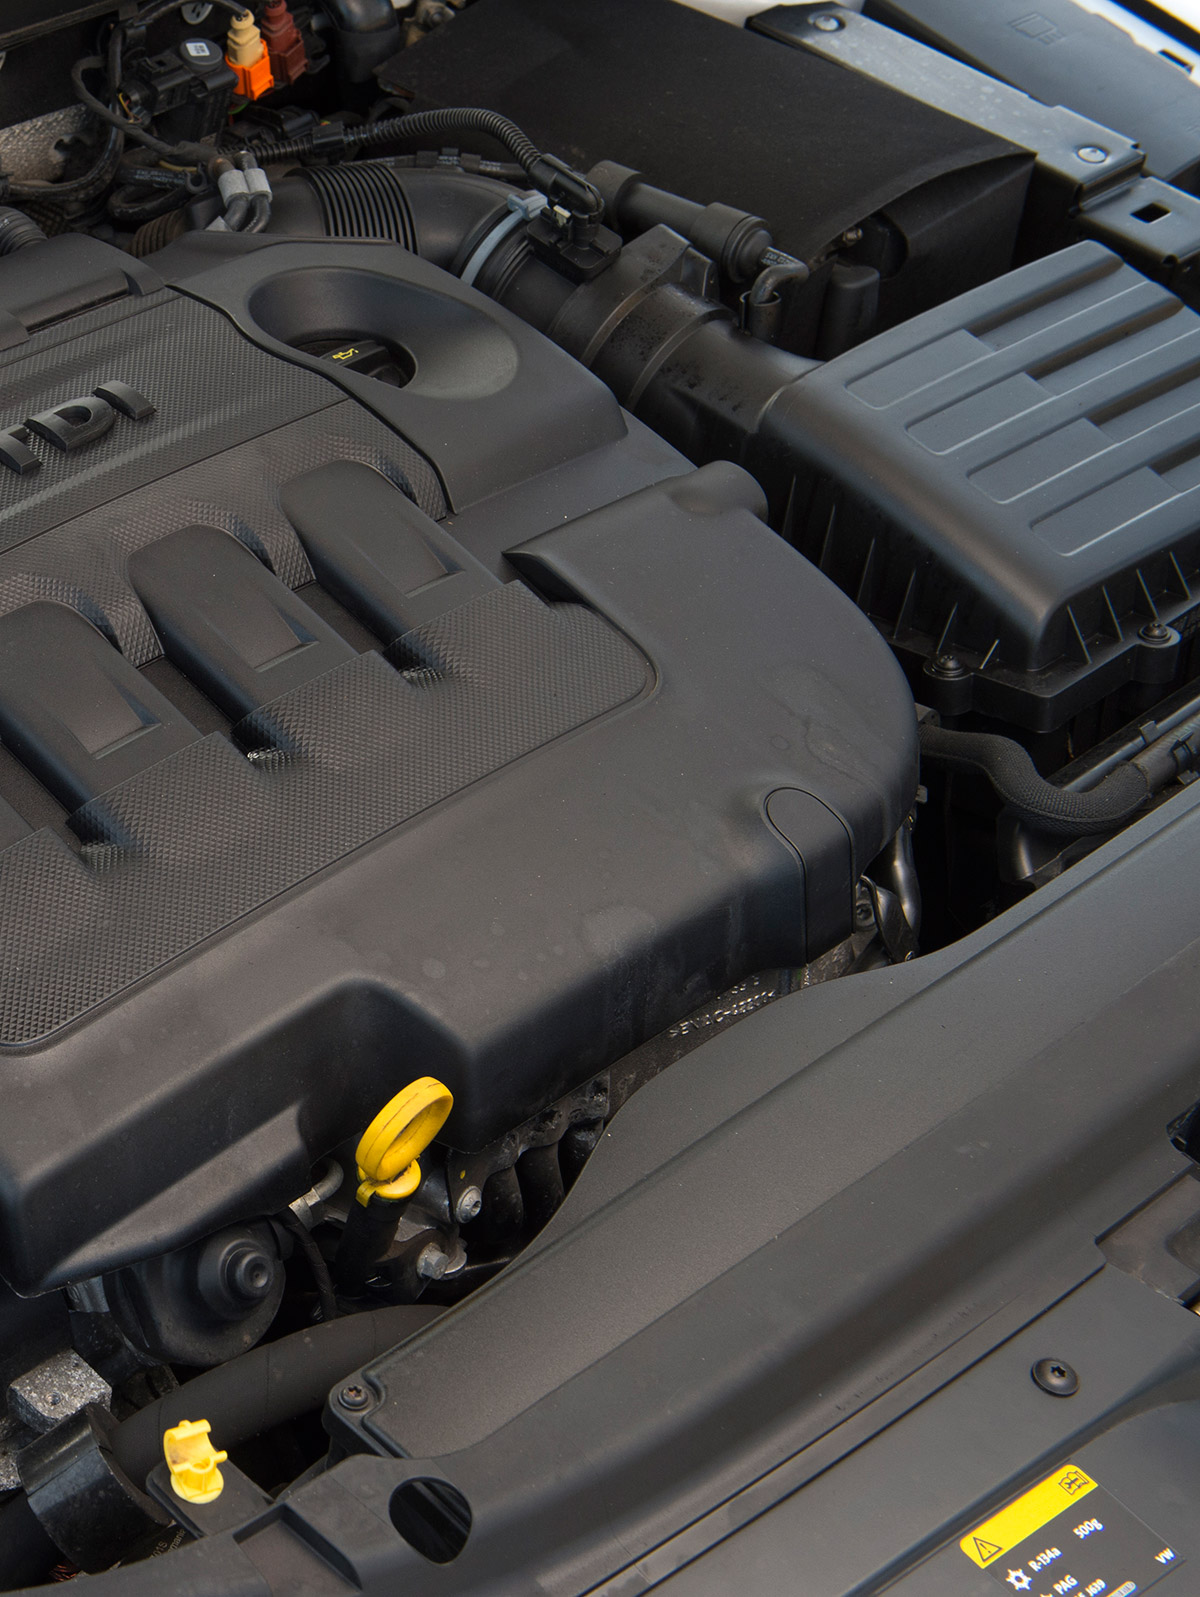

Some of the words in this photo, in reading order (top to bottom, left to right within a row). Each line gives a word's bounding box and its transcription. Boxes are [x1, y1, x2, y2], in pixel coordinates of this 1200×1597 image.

[1028, 1546, 1063, 1573] R-134a
[1072, 1517, 1104, 1540] 500g
[1154, 1547, 1177, 1565] VW
[1052, 1574, 1079, 1596] PAG
